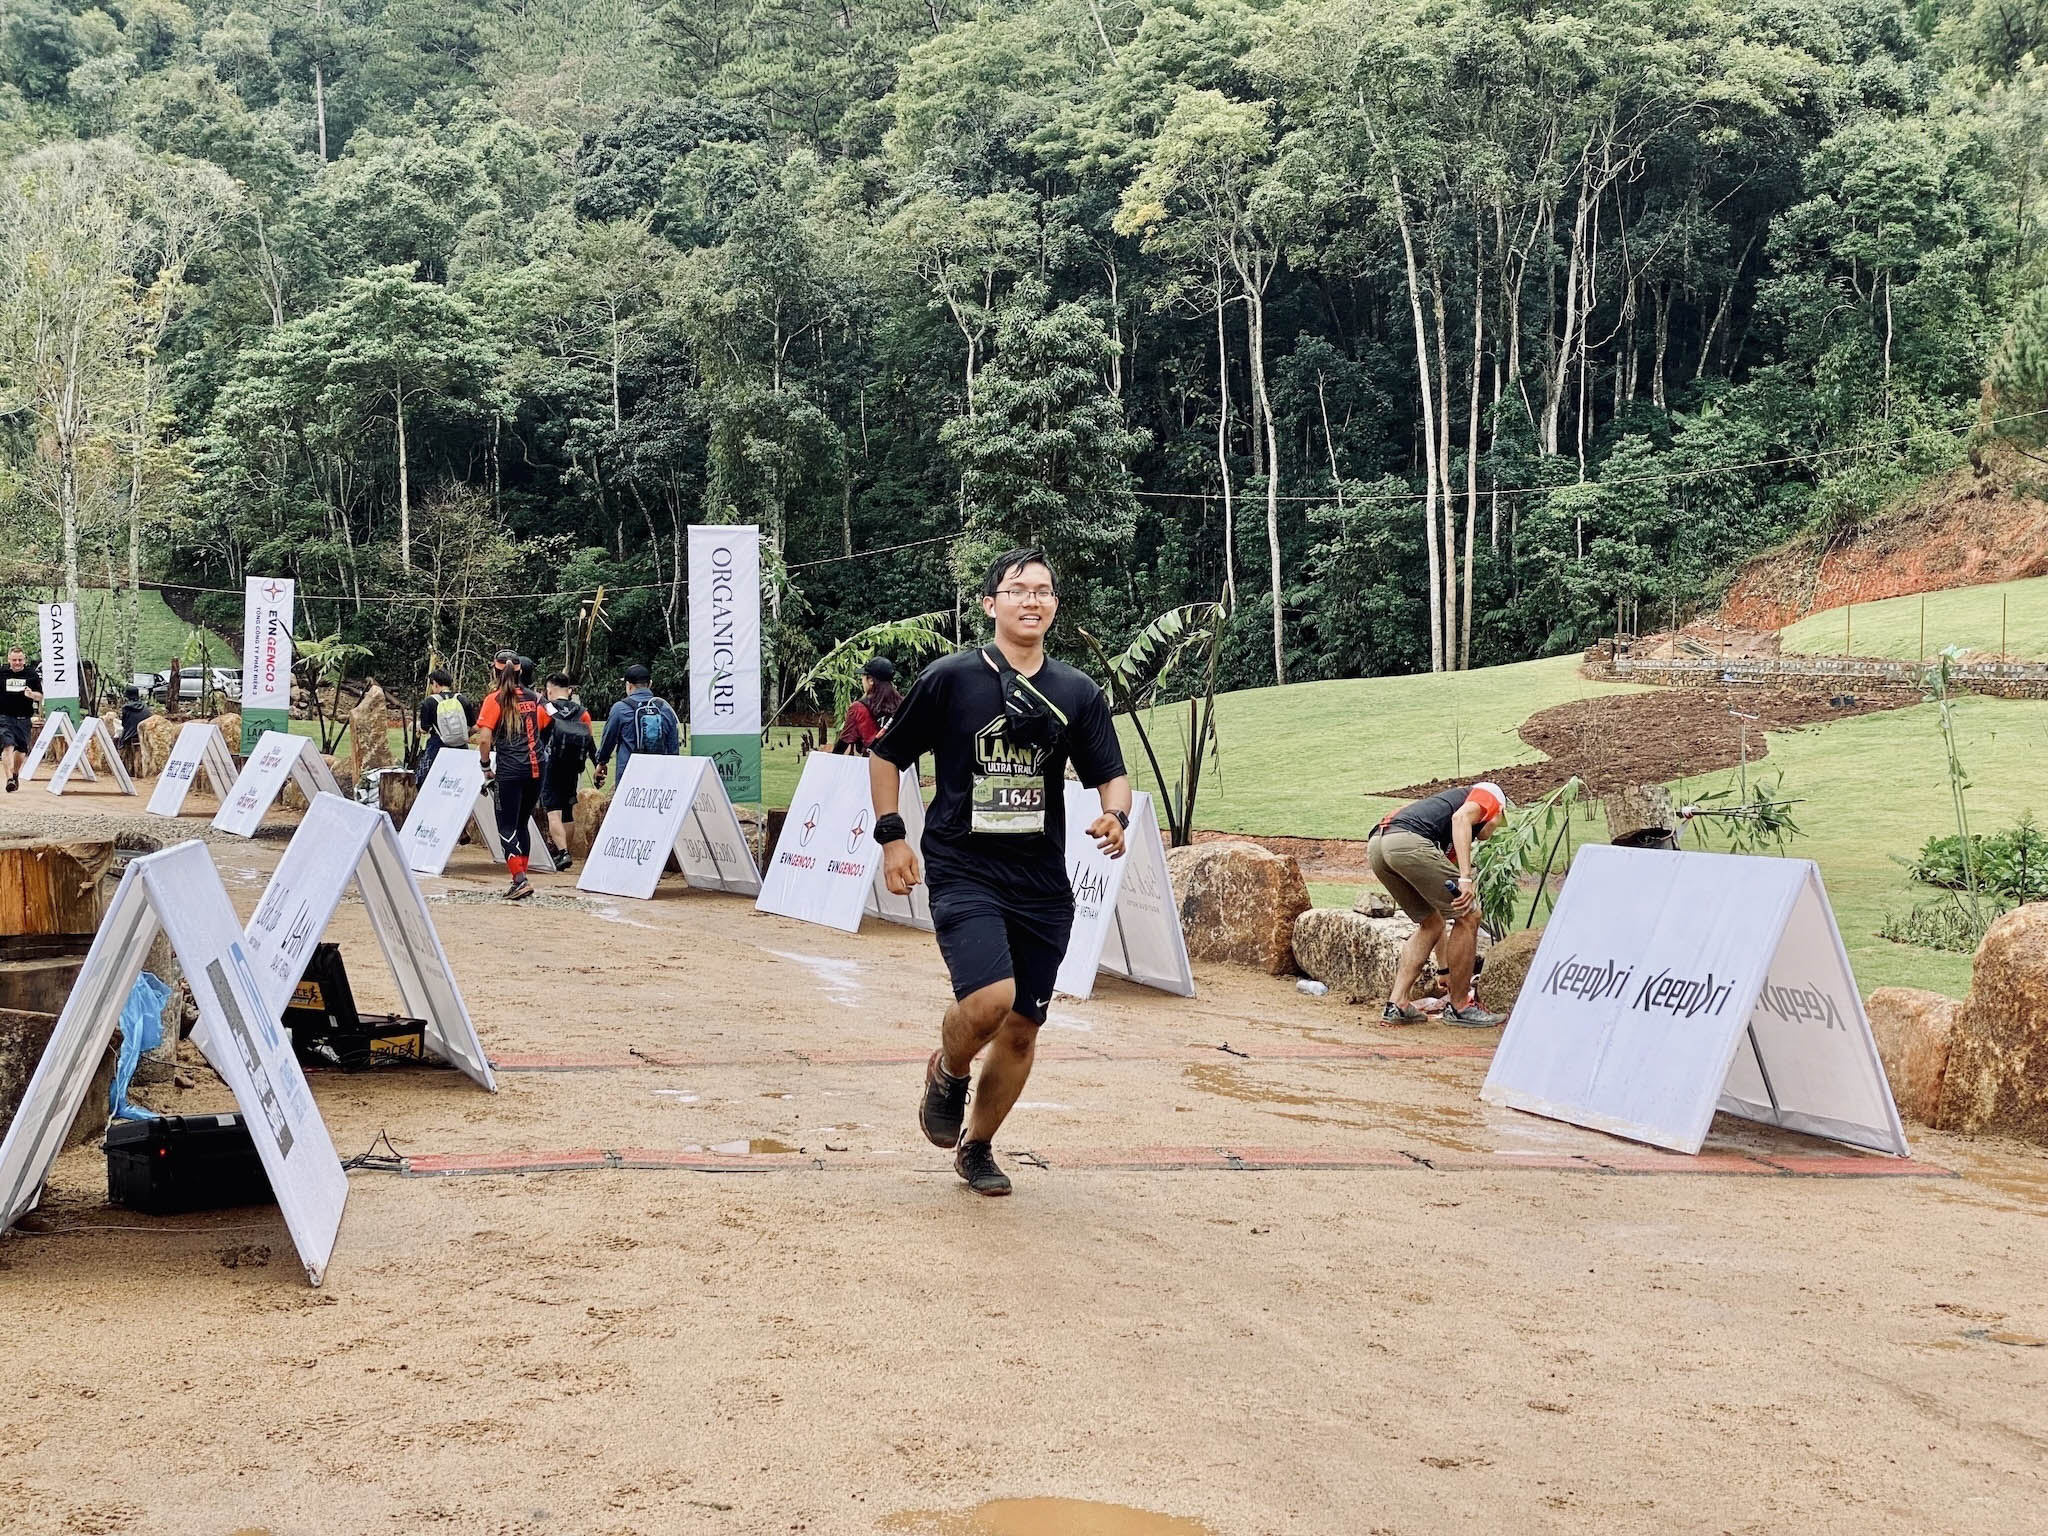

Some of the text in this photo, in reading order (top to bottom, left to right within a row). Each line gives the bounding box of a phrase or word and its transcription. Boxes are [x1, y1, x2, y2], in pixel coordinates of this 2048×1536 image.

[50, 604, 66, 682] GARMIN
[711, 547, 734, 716] ORGANICARE
[265, 610, 278, 693] EVNGENCO 3
[980, 738, 1032, 765] LAAN
[718, 763, 734, 776] AN
[988, 762, 1033, 775] ULTRA TRAIL
[624, 787, 677, 814] ORGANICARE
[998, 788, 1042, 806] 1645
[603, 836, 656, 865] ORGANICARE
[780, 852, 816, 869] EVNGENCO 3
[827, 860, 865, 877] EVNGENCO 3
